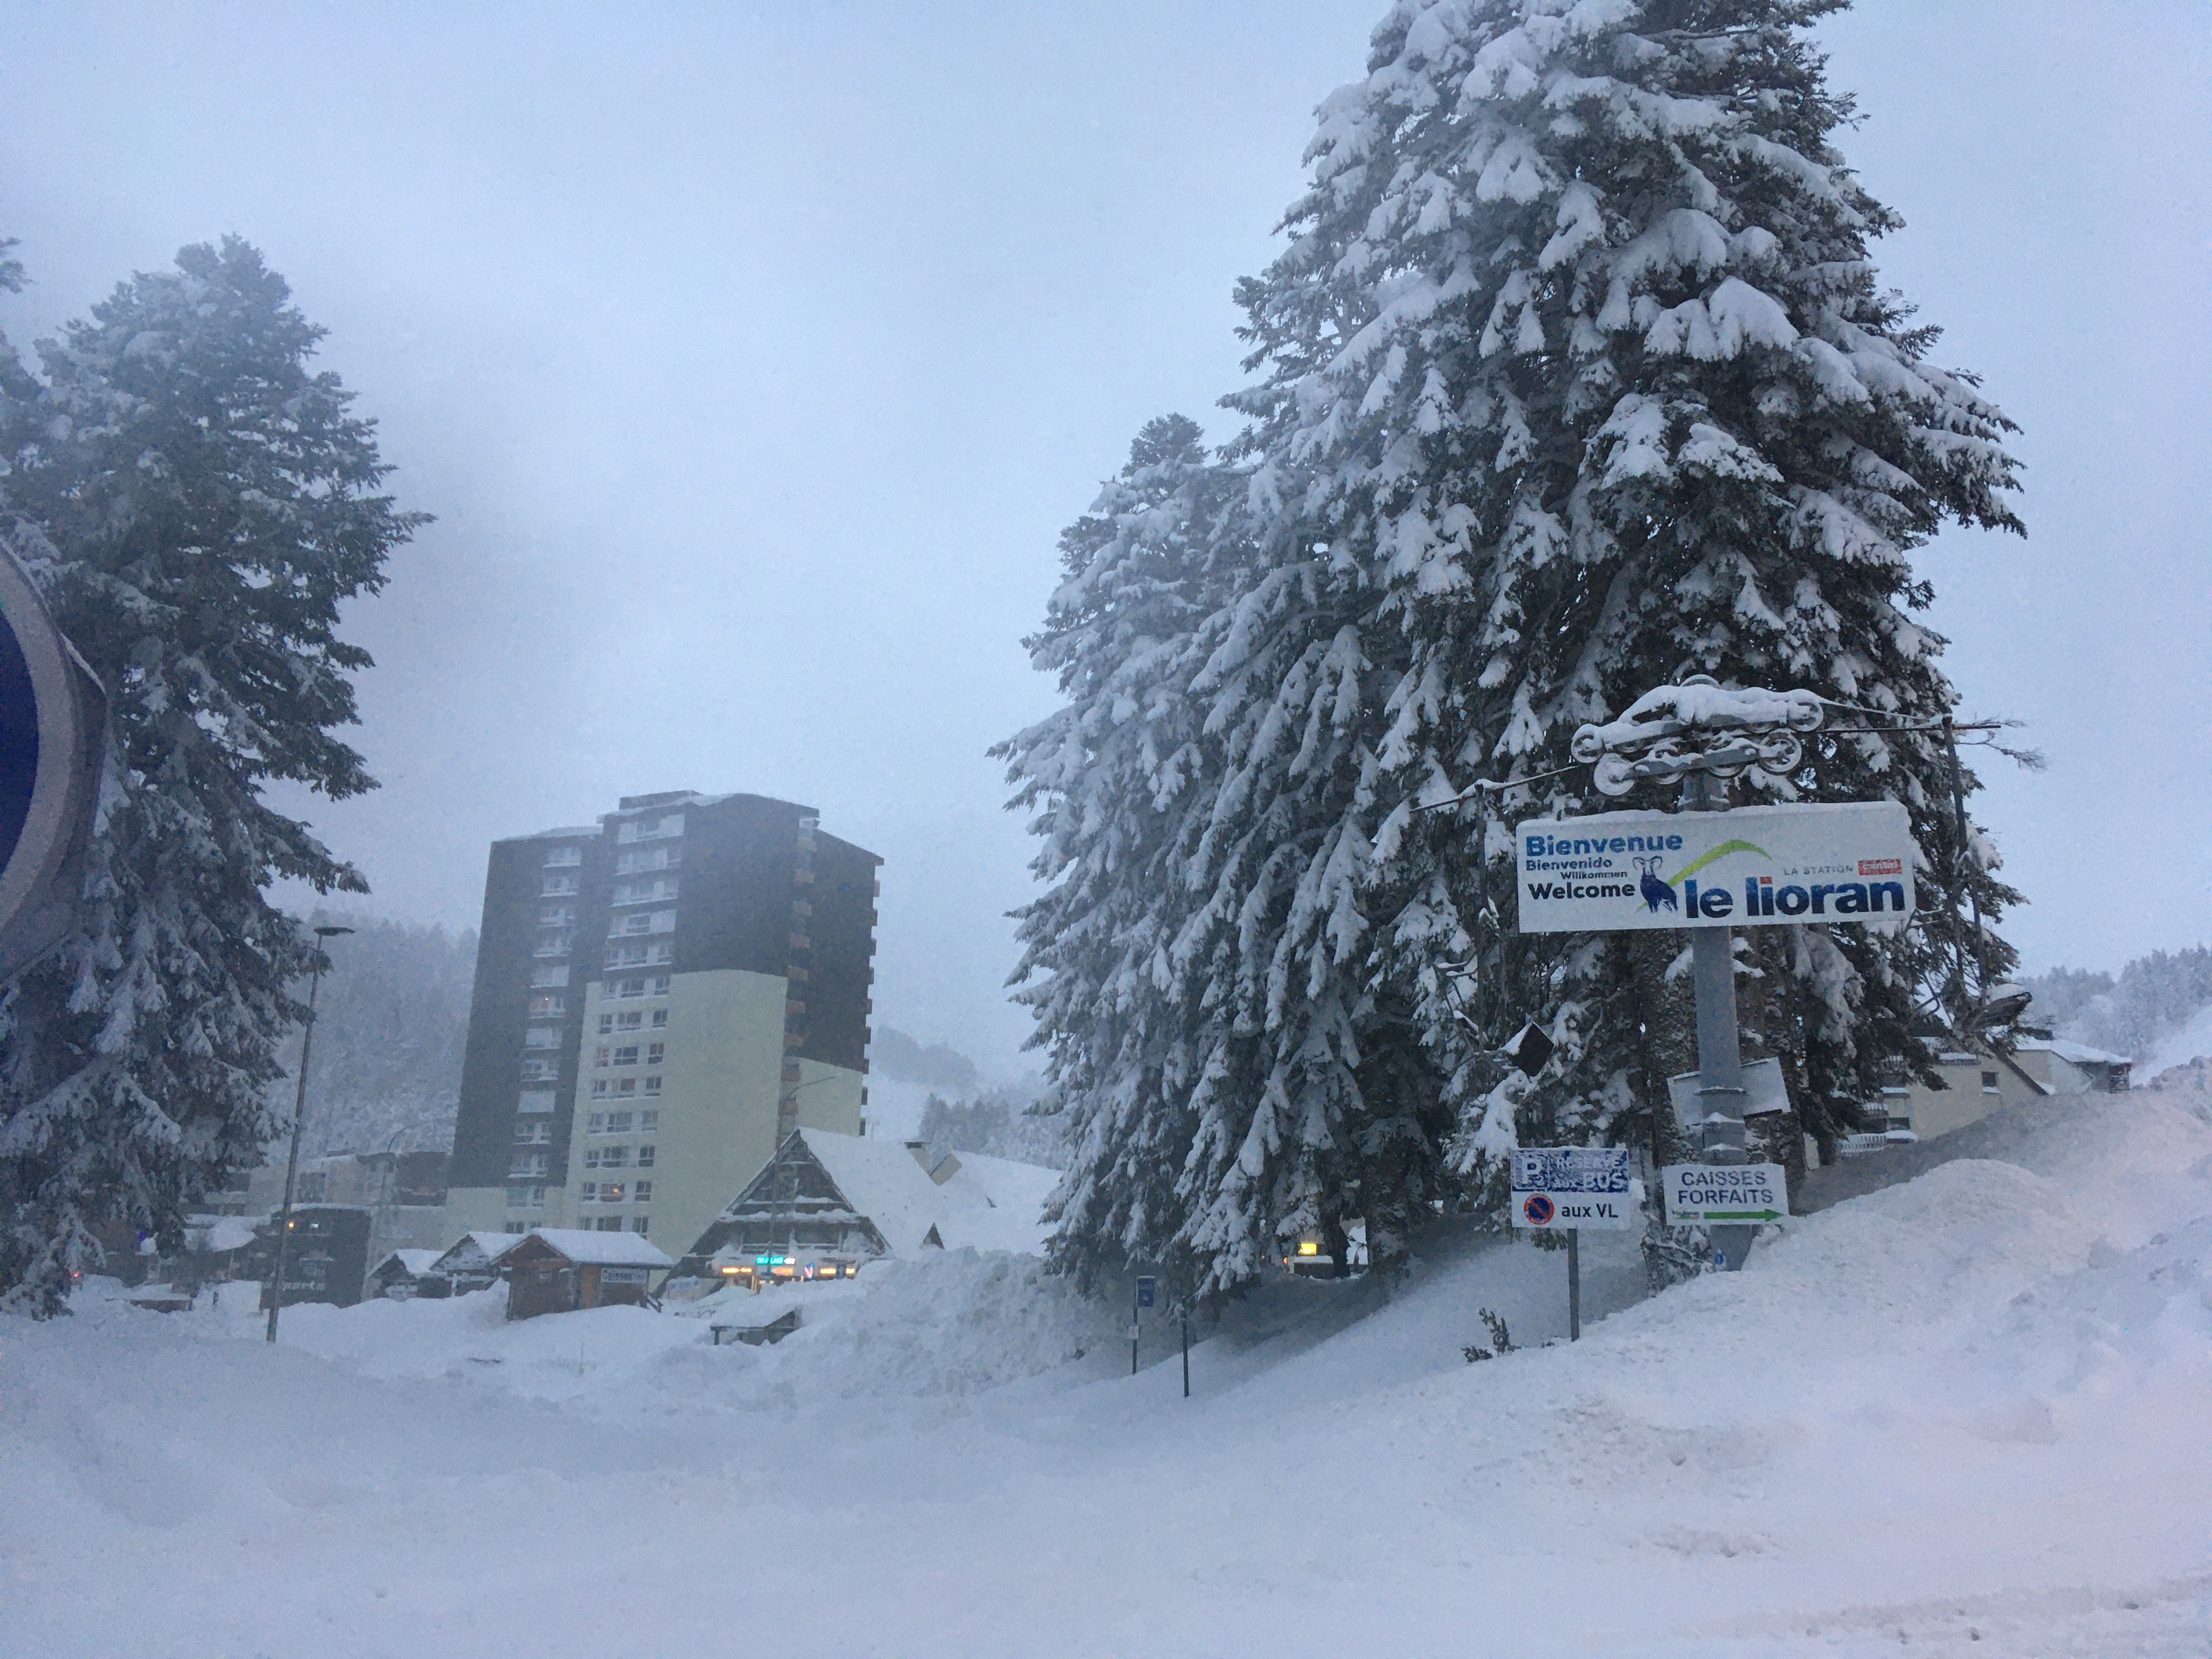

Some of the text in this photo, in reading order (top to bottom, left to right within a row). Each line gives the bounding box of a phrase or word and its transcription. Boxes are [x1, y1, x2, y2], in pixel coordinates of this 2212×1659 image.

[1525, 833, 1683, 856] Bienvenue
[1526, 857, 1612, 871] Bienvenido
[1784, 867, 1798, 876] LA
[1803, 865, 1853, 874] STATION
[1561, 870, 1628, 879] Willkommen
[1528, 882, 1635, 900] Welcome
[1685, 876, 1905, 918] le lioran
[1584, 1172, 1623, 1189] BUS
[1681, 1171, 1766, 1186] CAISSES
[1678, 1189, 1773, 1204] FORFAITS
[1561, 1203, 1619, 1218] aux VL
